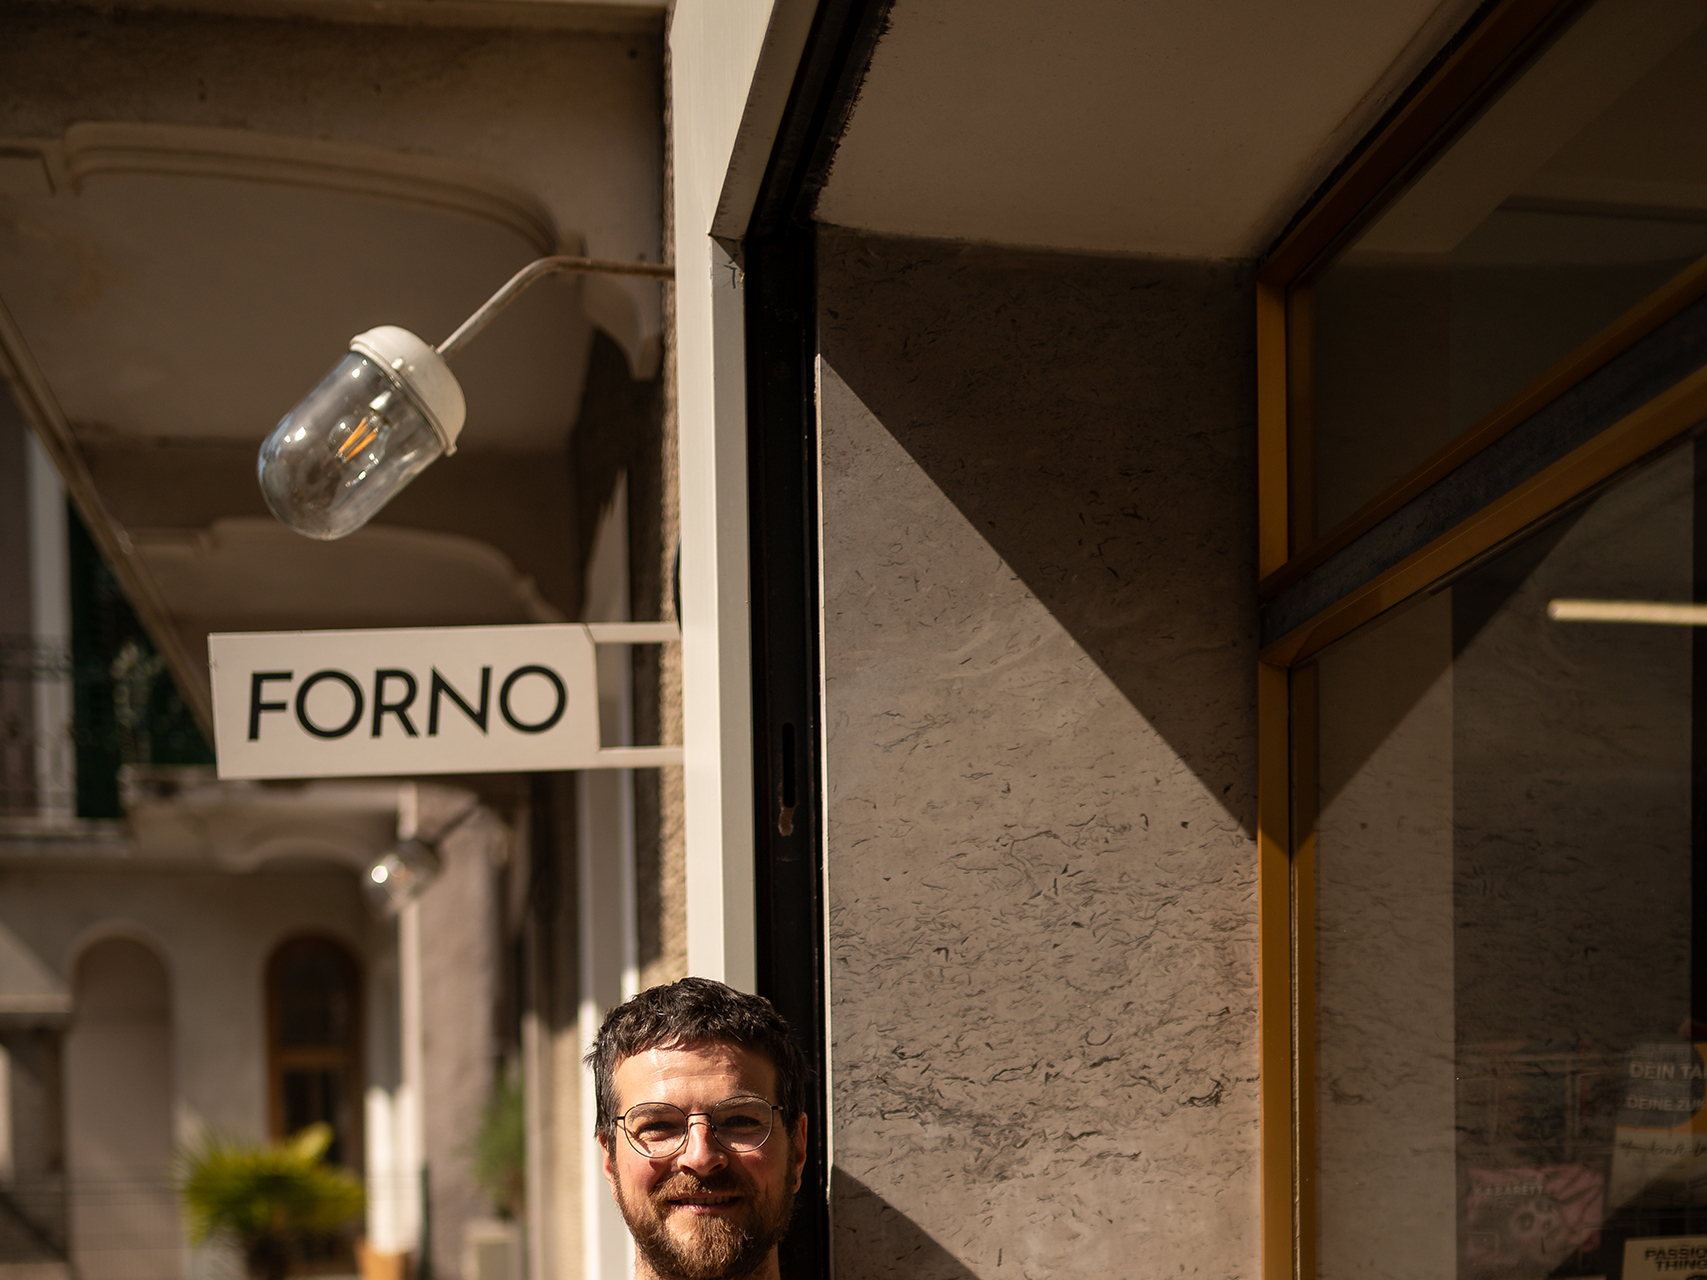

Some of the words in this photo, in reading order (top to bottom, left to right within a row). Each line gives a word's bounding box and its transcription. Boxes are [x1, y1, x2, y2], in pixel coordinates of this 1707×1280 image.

[247, 664, 566, 742] FORNO
[1629, 1060, 1675, 1079] DEIN
[1626, 1094, 1672, 1111] DEINE
